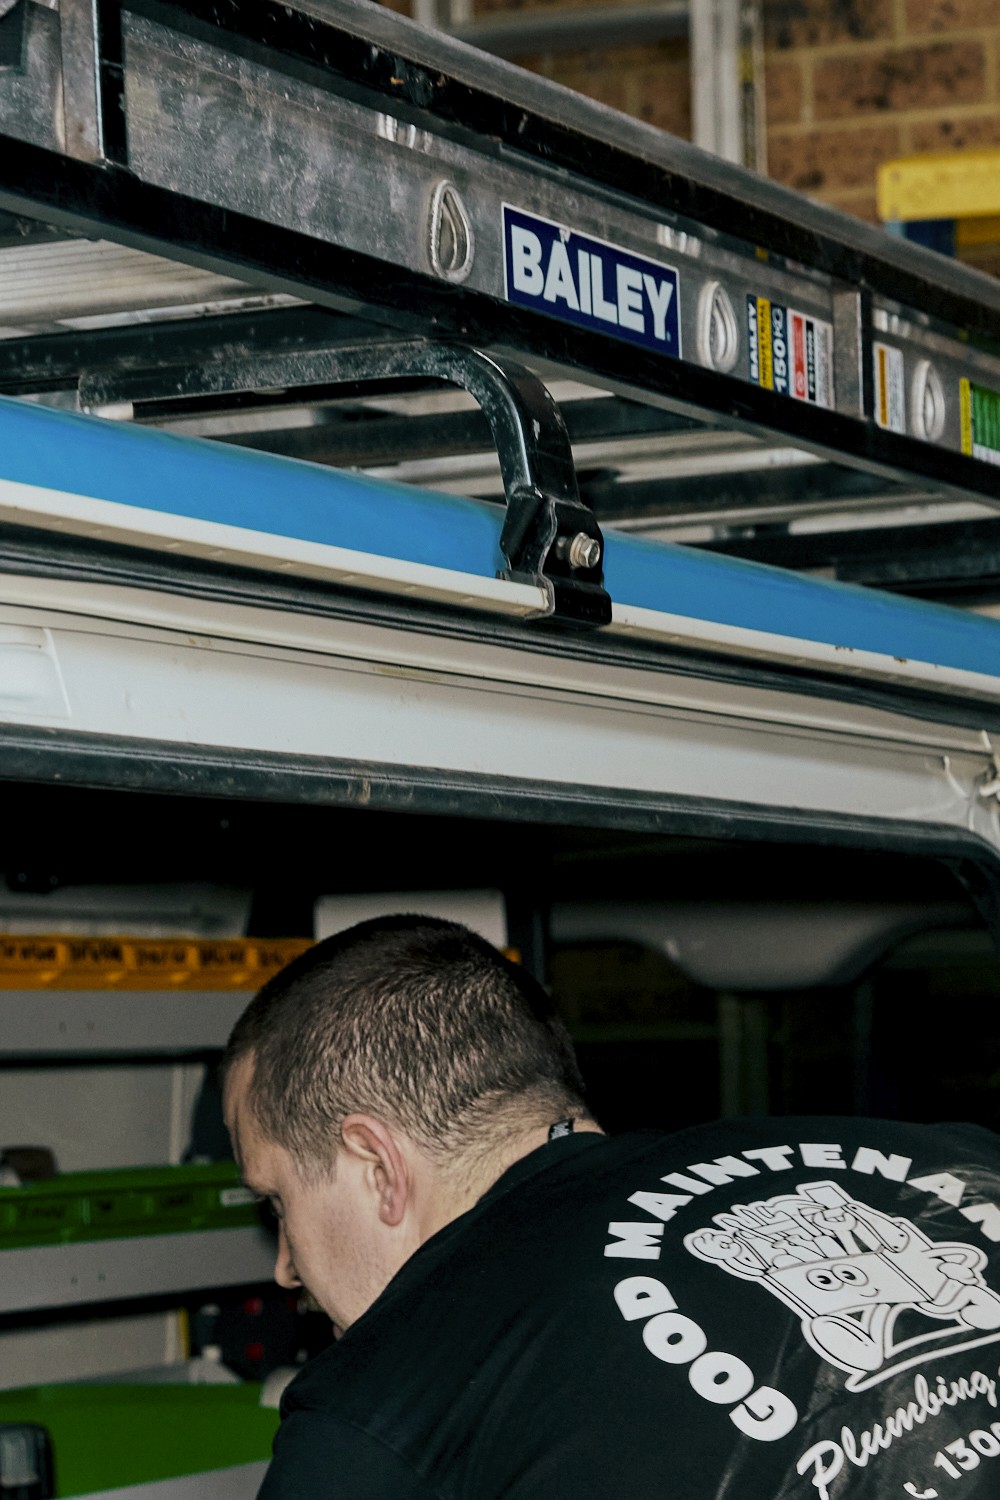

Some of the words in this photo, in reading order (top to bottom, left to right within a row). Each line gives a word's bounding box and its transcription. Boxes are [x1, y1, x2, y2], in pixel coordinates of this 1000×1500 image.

[511, 224, 674, 340] BAILEY
[749, 303, 758, 378] BAILEY
[613, 1276, 798, 1441] GOOD
